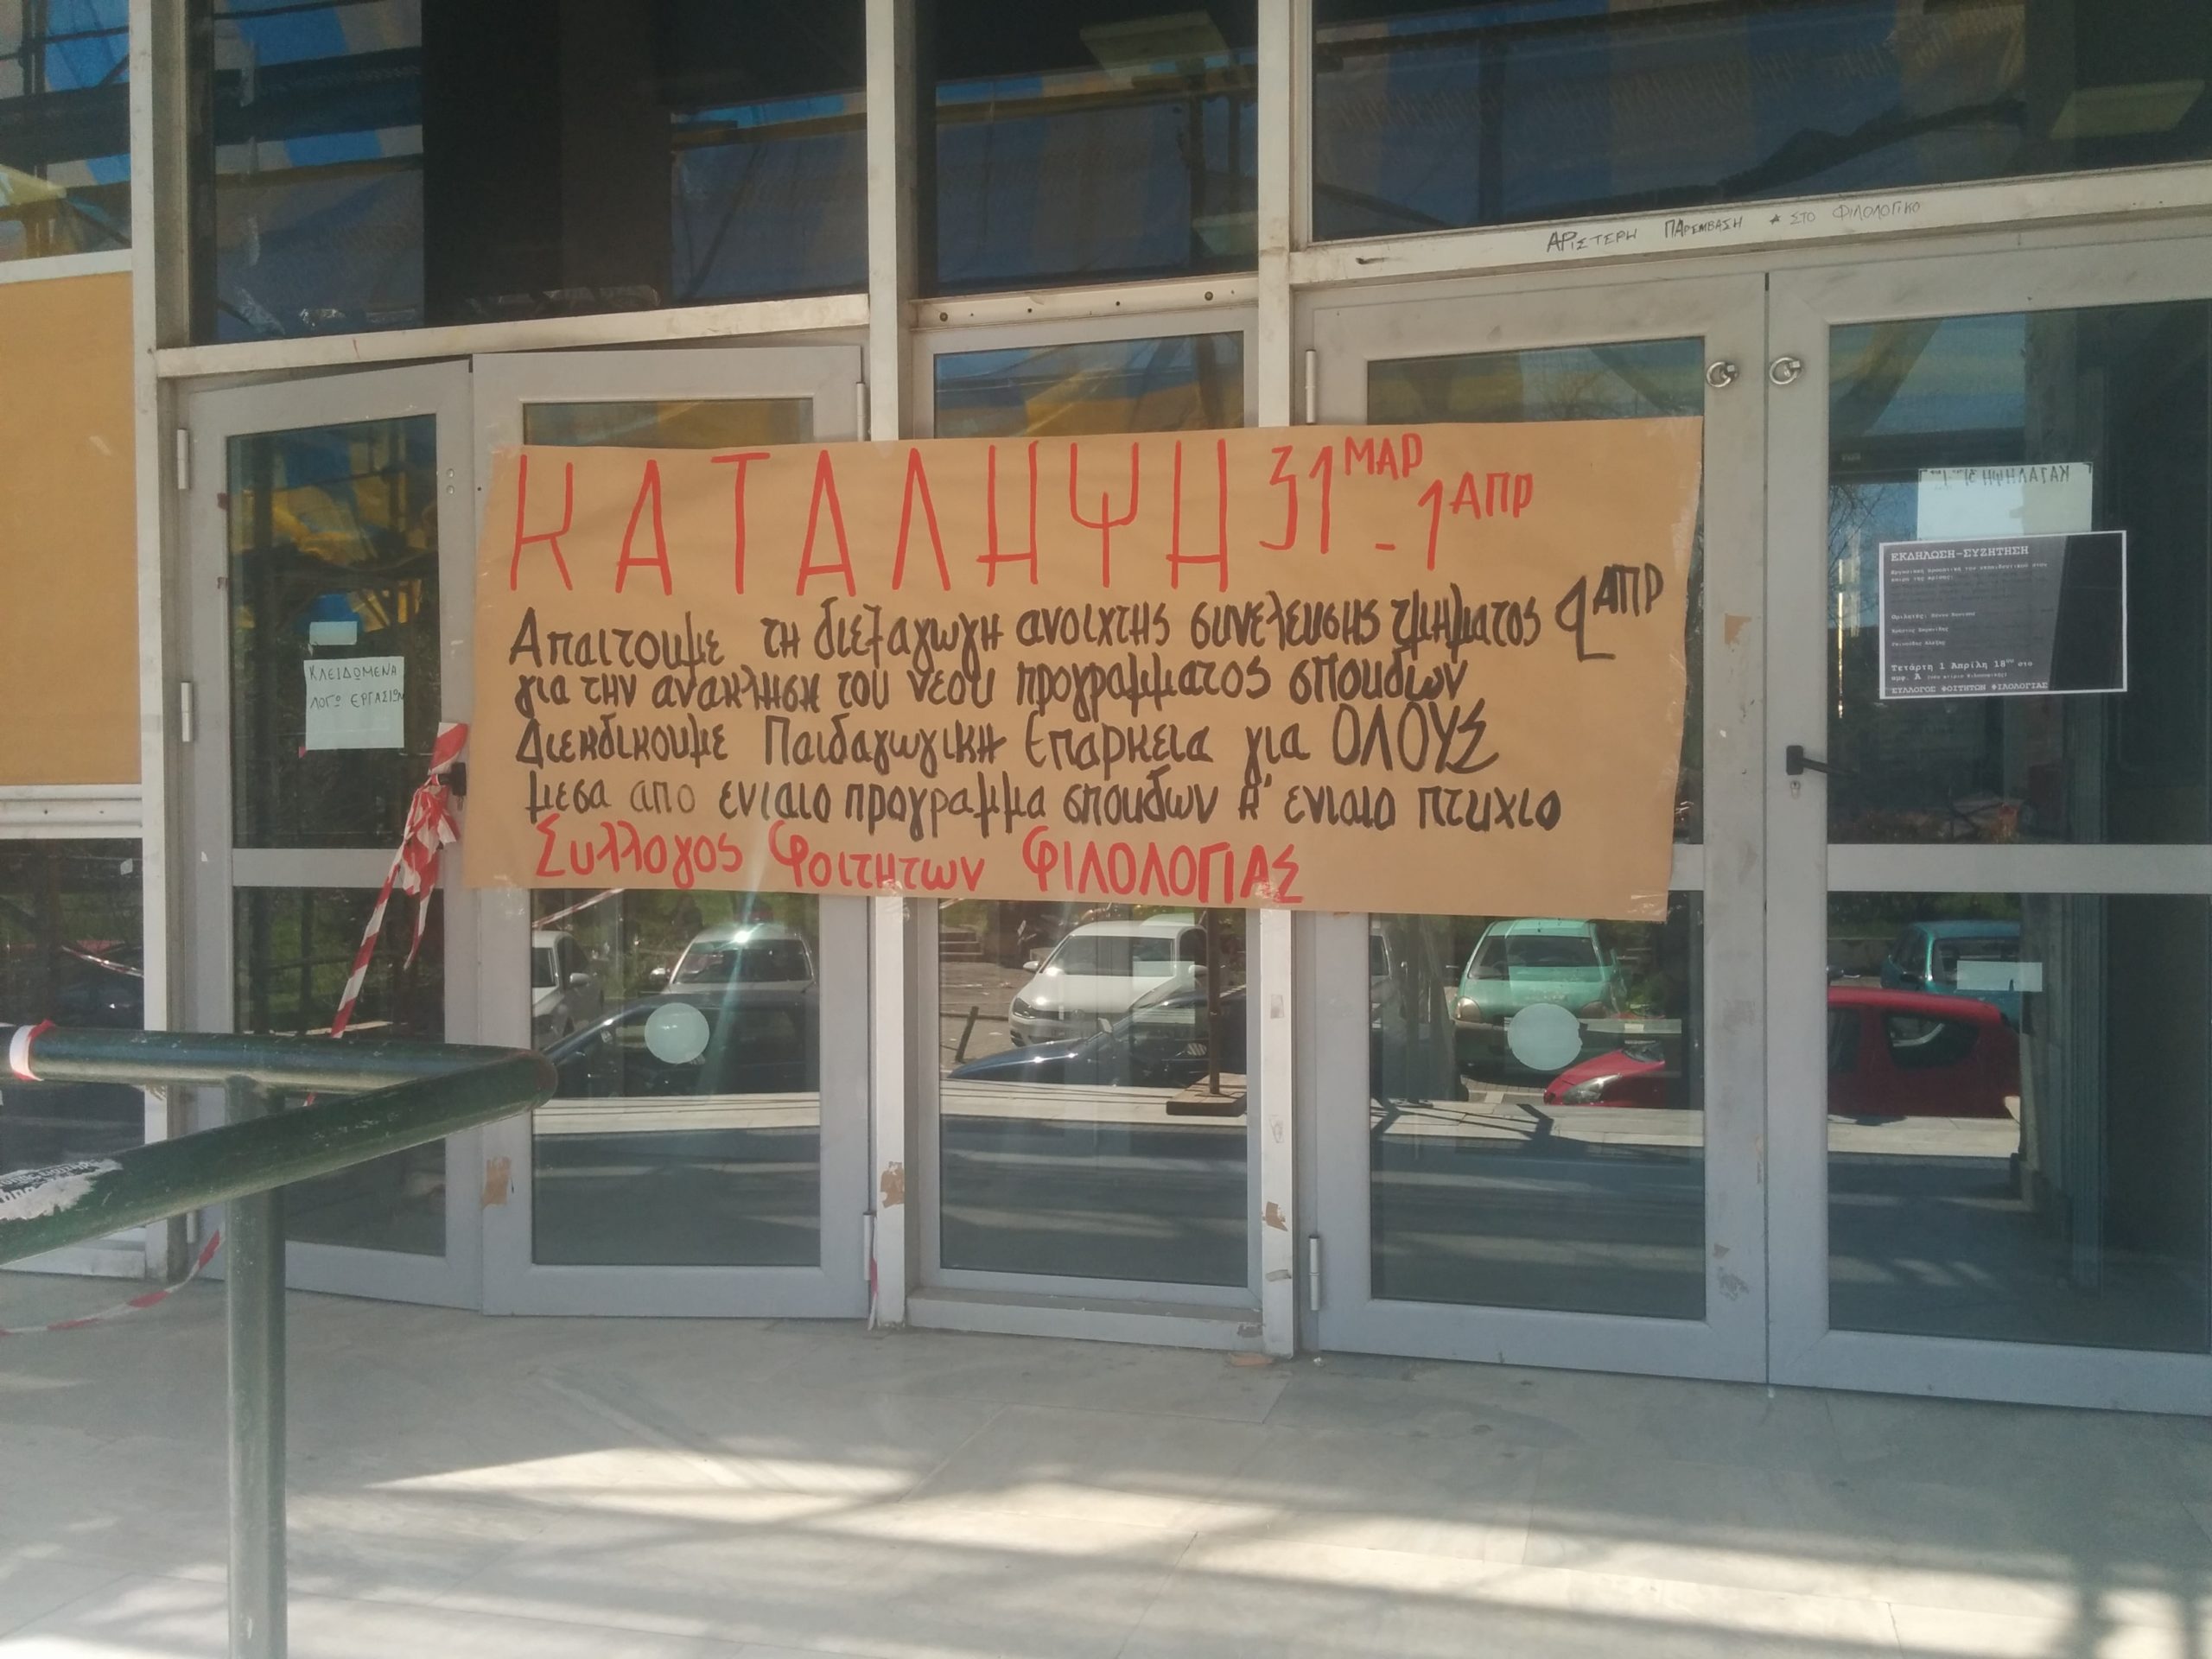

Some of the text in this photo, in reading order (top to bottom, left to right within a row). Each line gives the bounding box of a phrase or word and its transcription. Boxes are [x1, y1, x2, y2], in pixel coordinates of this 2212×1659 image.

[510, 439, 1228, 598] ΚΑΤΑΛΗΨΗ
[1332, 698, 1499, 774] ΟΛΟΥΣ
[1021, 825, 1305, 905] ΦΙΛΟΛΟΓΙΑΣ
